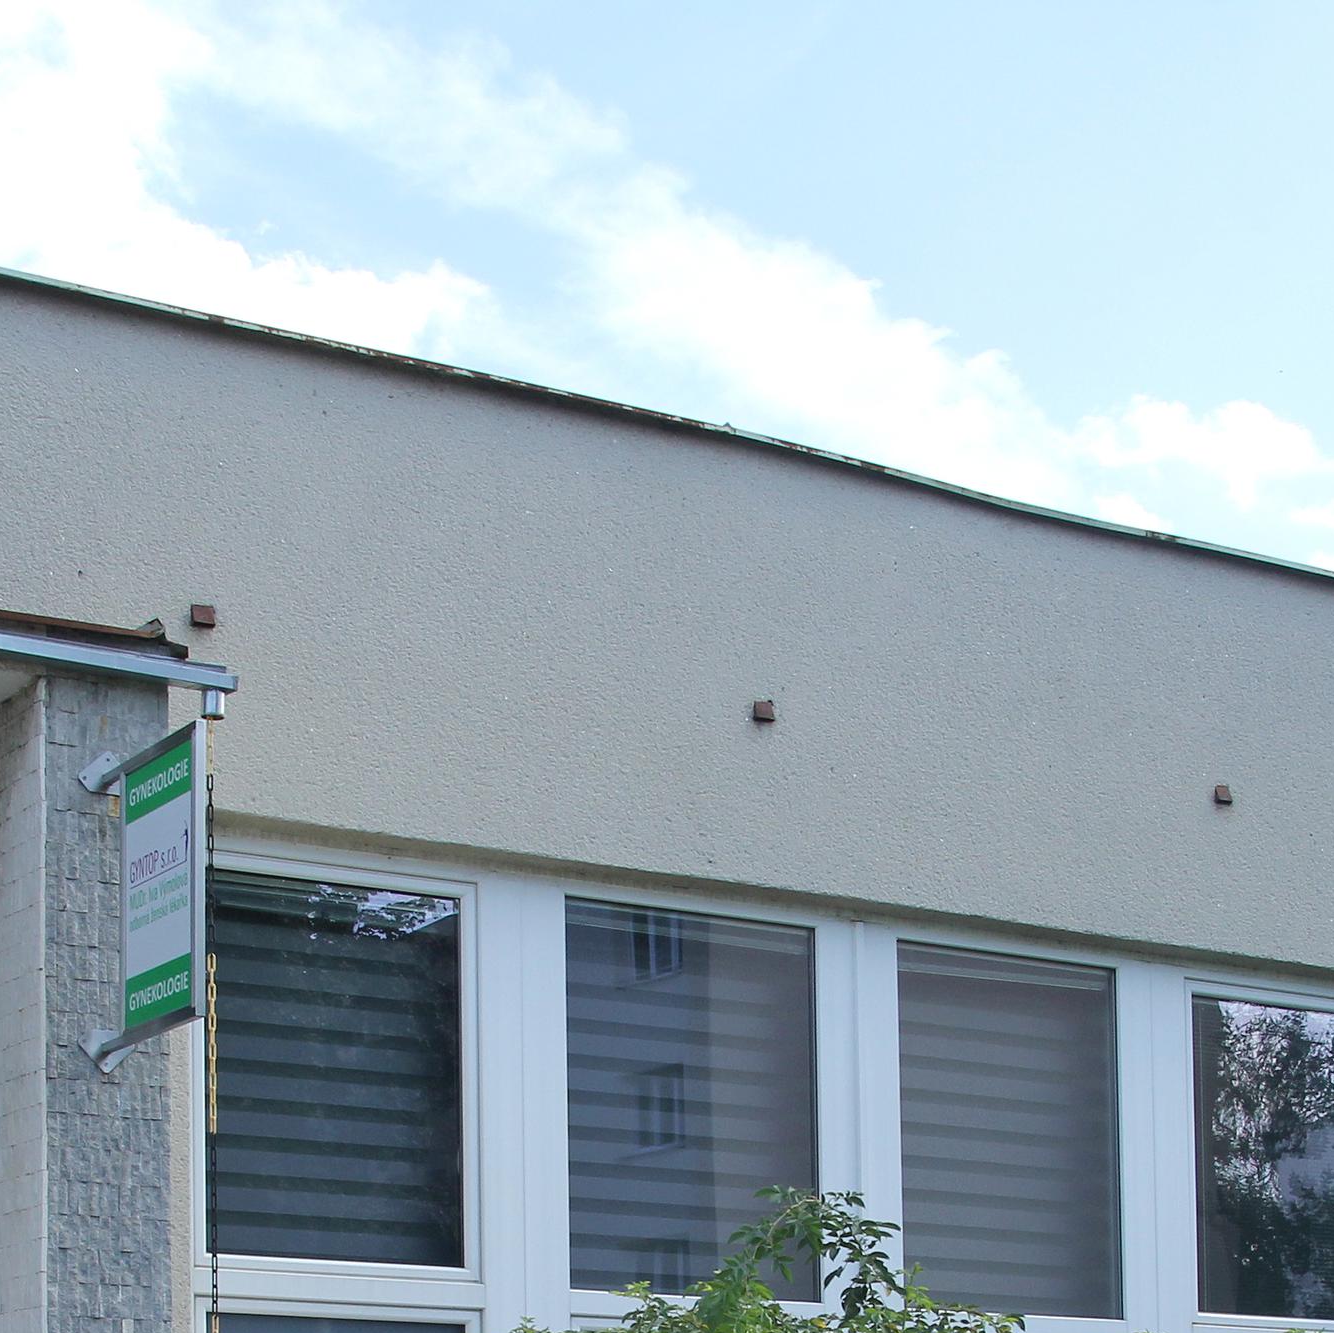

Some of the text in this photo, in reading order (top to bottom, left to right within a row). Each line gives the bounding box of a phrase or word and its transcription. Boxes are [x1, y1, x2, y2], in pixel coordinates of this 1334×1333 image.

[129, 758, 189, 806] GYNEKOLOGIE
[130, 850, 159, 883] GYNTOP
[129, 971, 189, 1011] GYNEKOLOGIE
